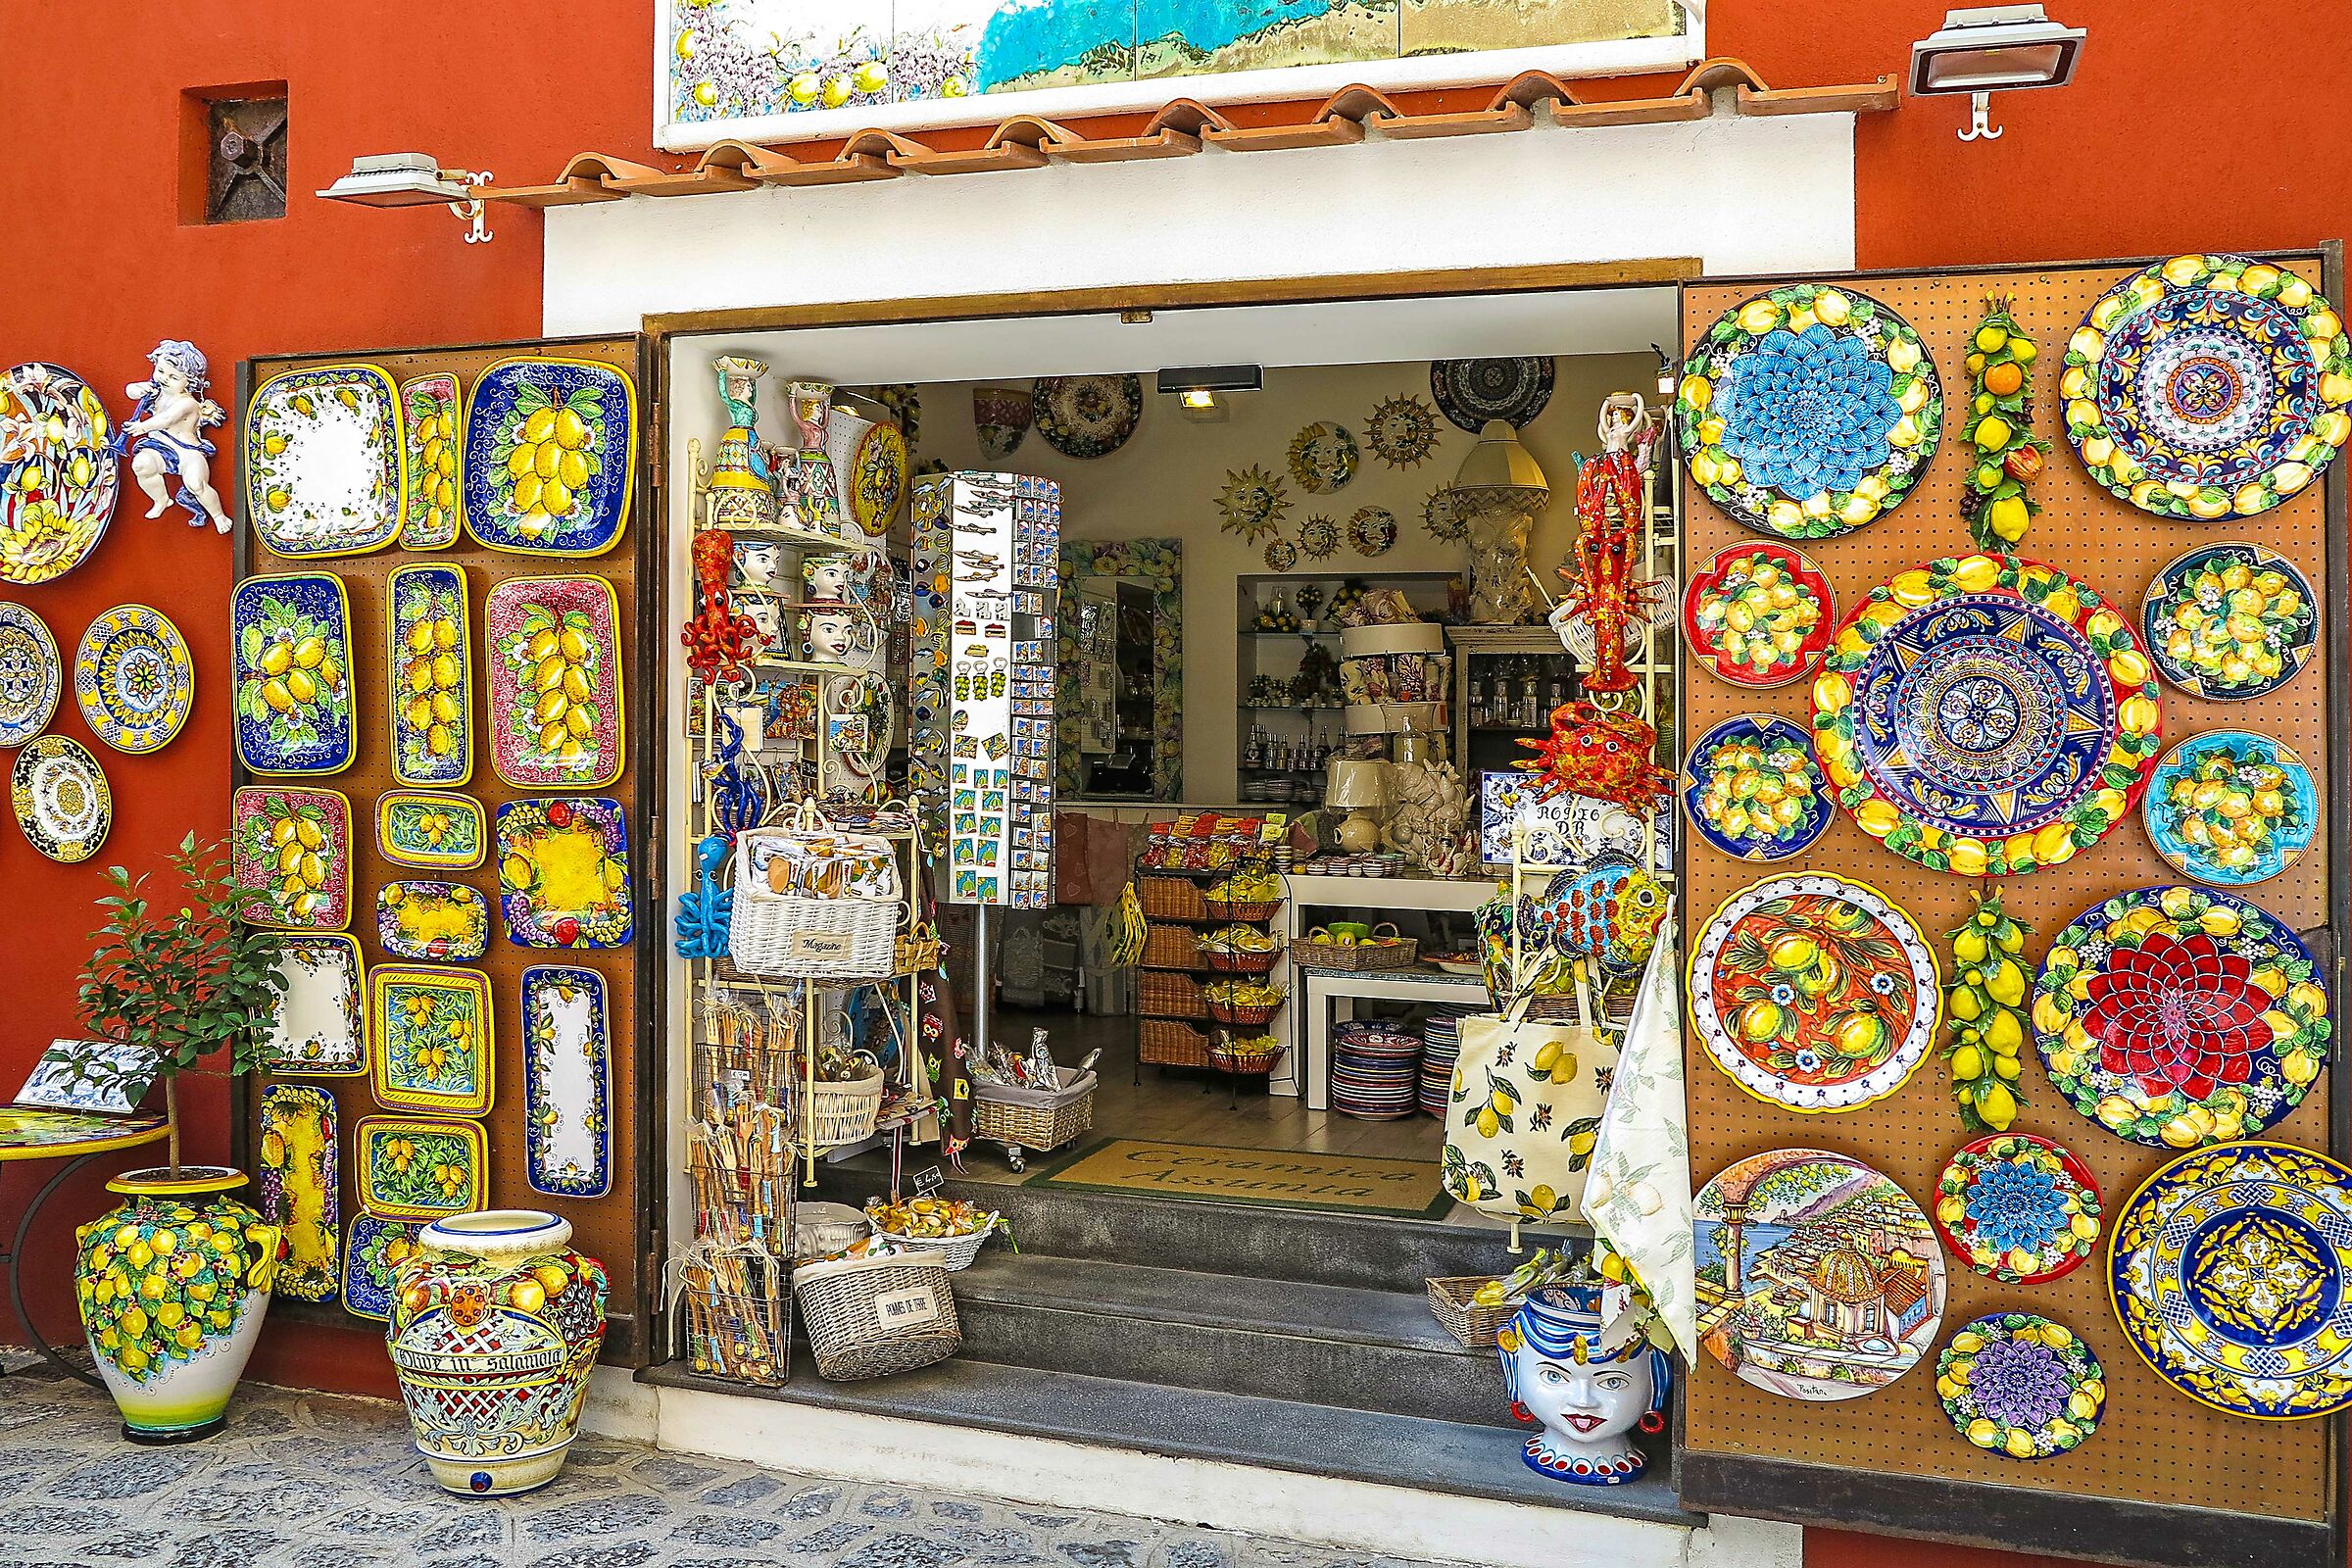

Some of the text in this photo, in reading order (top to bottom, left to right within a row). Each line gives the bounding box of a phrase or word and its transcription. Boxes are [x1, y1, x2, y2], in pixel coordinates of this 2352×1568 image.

[803, 938, 842, 953] Magazine
[1126, 1150, 1417, 1182] Ceramica
[1121, 1168, 1375, 1198] Assunta
[450, 1356, 472, 1372] in
